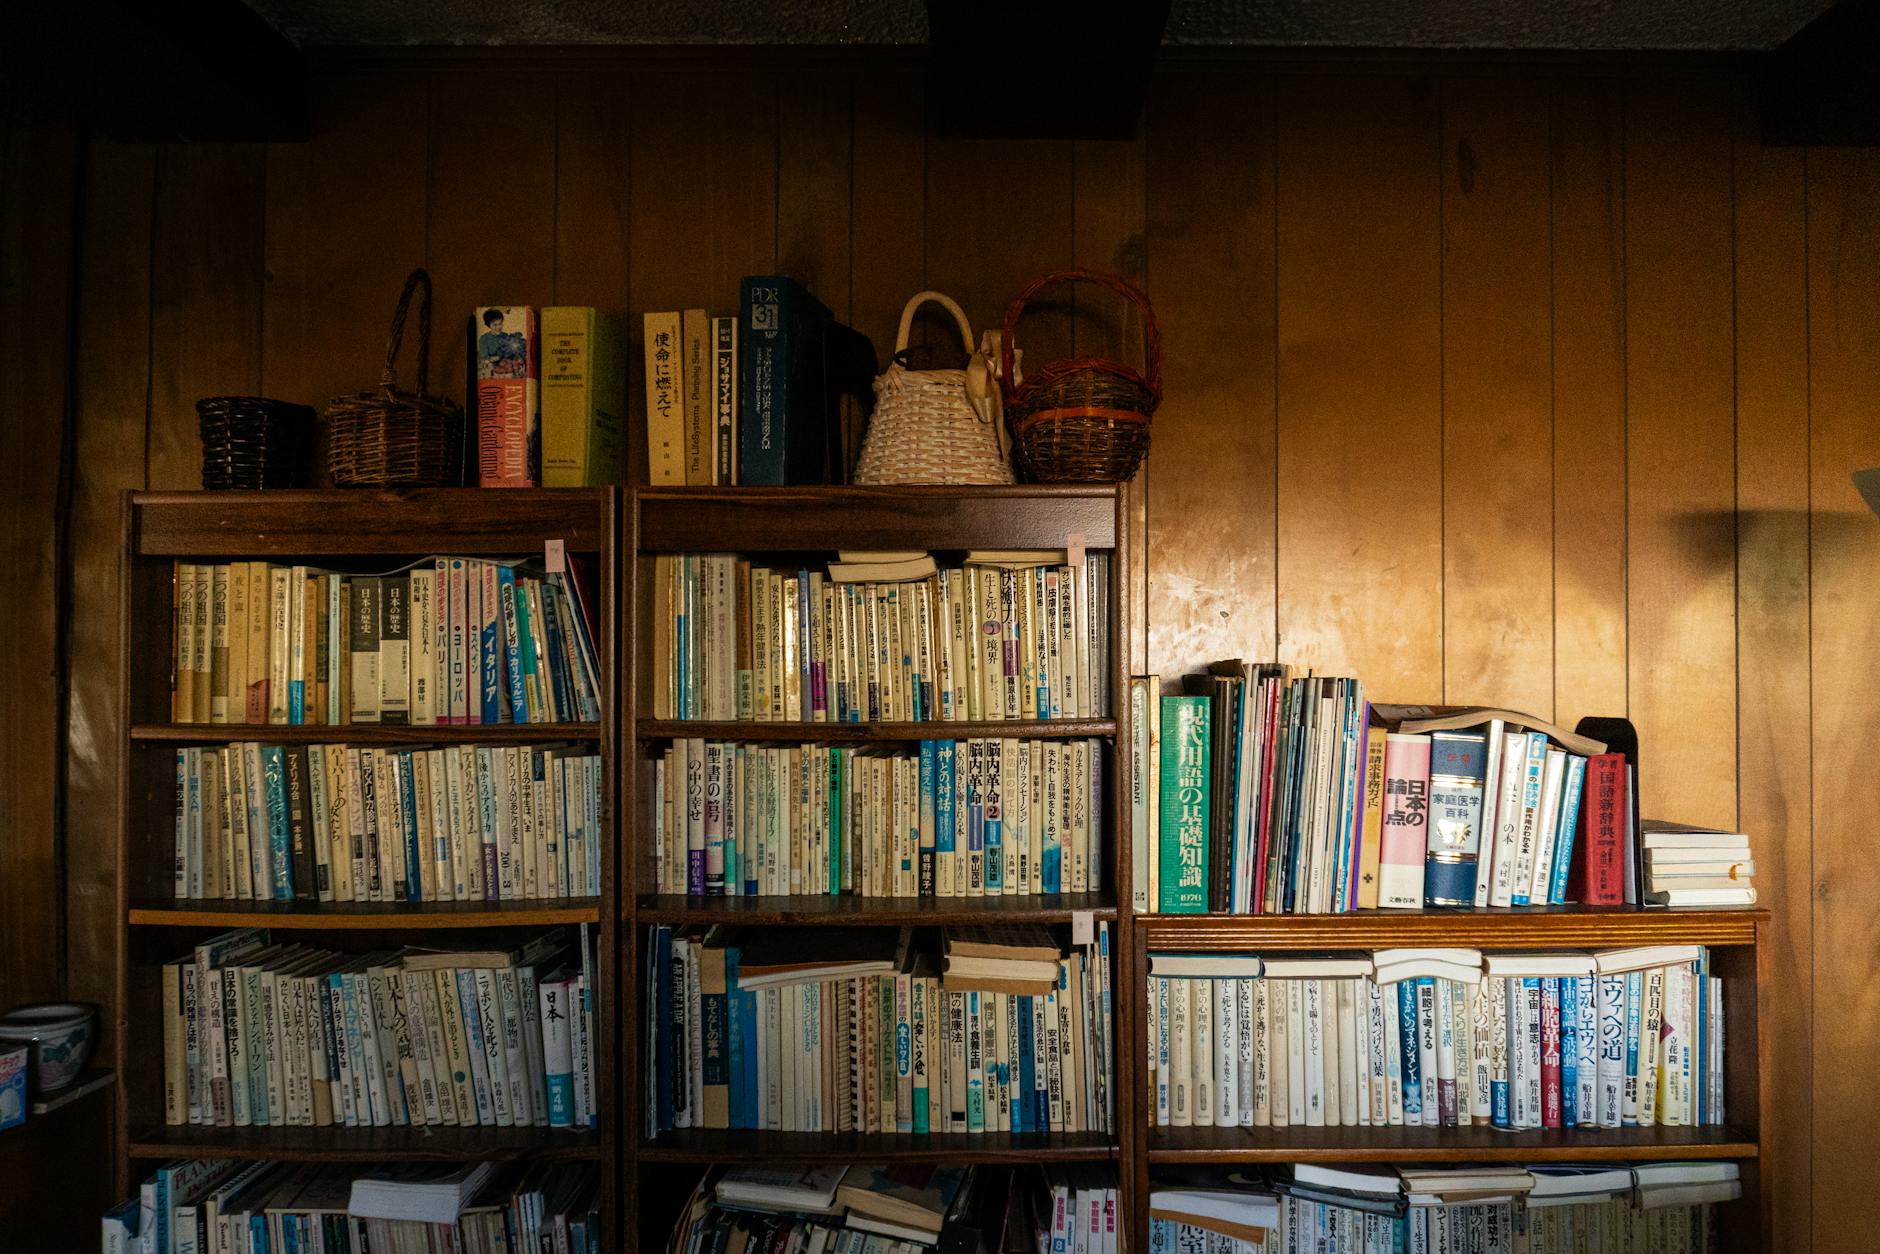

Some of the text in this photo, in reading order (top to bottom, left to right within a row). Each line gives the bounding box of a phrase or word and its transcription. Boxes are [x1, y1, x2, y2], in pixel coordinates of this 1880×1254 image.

[752, 287, 779, 302] PDR
[755, 305, 777, 329] 31
[656, 331, 672, 418] 使命に燃えて
[691, 361, 701, 401] Planning
[505, 384, 522, 478] ENCYCLOPEDIA
[691, 454, 701, 473] The
[180, 571, 194, 626] 二つの祖国
[196, 571, 209, 626] 二つの祖国
[214, 571, 228, 626] 二つの祖国
[361, 587, 372, 635] 日本の歴史
[390, 587, 402, 635] 日本の歴史
[437, 633, 448, 664] パリ
[453, 633, 464, 703] ヨーロッパ
[471, 633, 480, 674] スペイン
[485, 635, 498, 704] イタリア
[510, 659, 527, 713] カリフォルニア
[330, 747, 346, 842] ハーバードの女たち
[689, 759, 703, 822] の中の幸せ
[938, 746, 952, 812] 神との対話
[969, 742, 984, 806] 脳内革命
[1047, 749, 1059, 842] 失われし自我をもとめて
[1134, 751, 1142, 805] ASSISTANT
[1178, 703, 1204, 888] 現代用語の基礎知識
[1366, 755, 1383, 808] 請求事務ガイド
[1432, 792, 1480, 809] 家庭医学
[1386, 778, 1407, 826] 論点
[1406, 778, 1427, 826] 日本の
[1445, 807, 1469, 821] 百科
[1599, 771, 1615, 839] 国語新辞典
[1180, 893, 1203, 902] 1976
[280, 981, 293, 1038] みにくい日本人
[545, 992, 566, 1023] 日本
[1421, 987, 1434, 1051] 細胞で考える
[1472, 989, 1491, 1061] 人生の価値
[1528, 989, 1539, 1065] 宇宙には意志がある
[1601, 976, 1622, 1062] エヴァへの道
[1645, 974, 1663, 1032] 百匹目の猿
[1669, 1036, 1679, 1065] 立花隆
[1582, 1083, 1593, 1121] 船井幸雄
[1606, 1084, 1617, 1122] 船井幸雄
[1643, 1080, 1656, 1111] 船井幸雄
